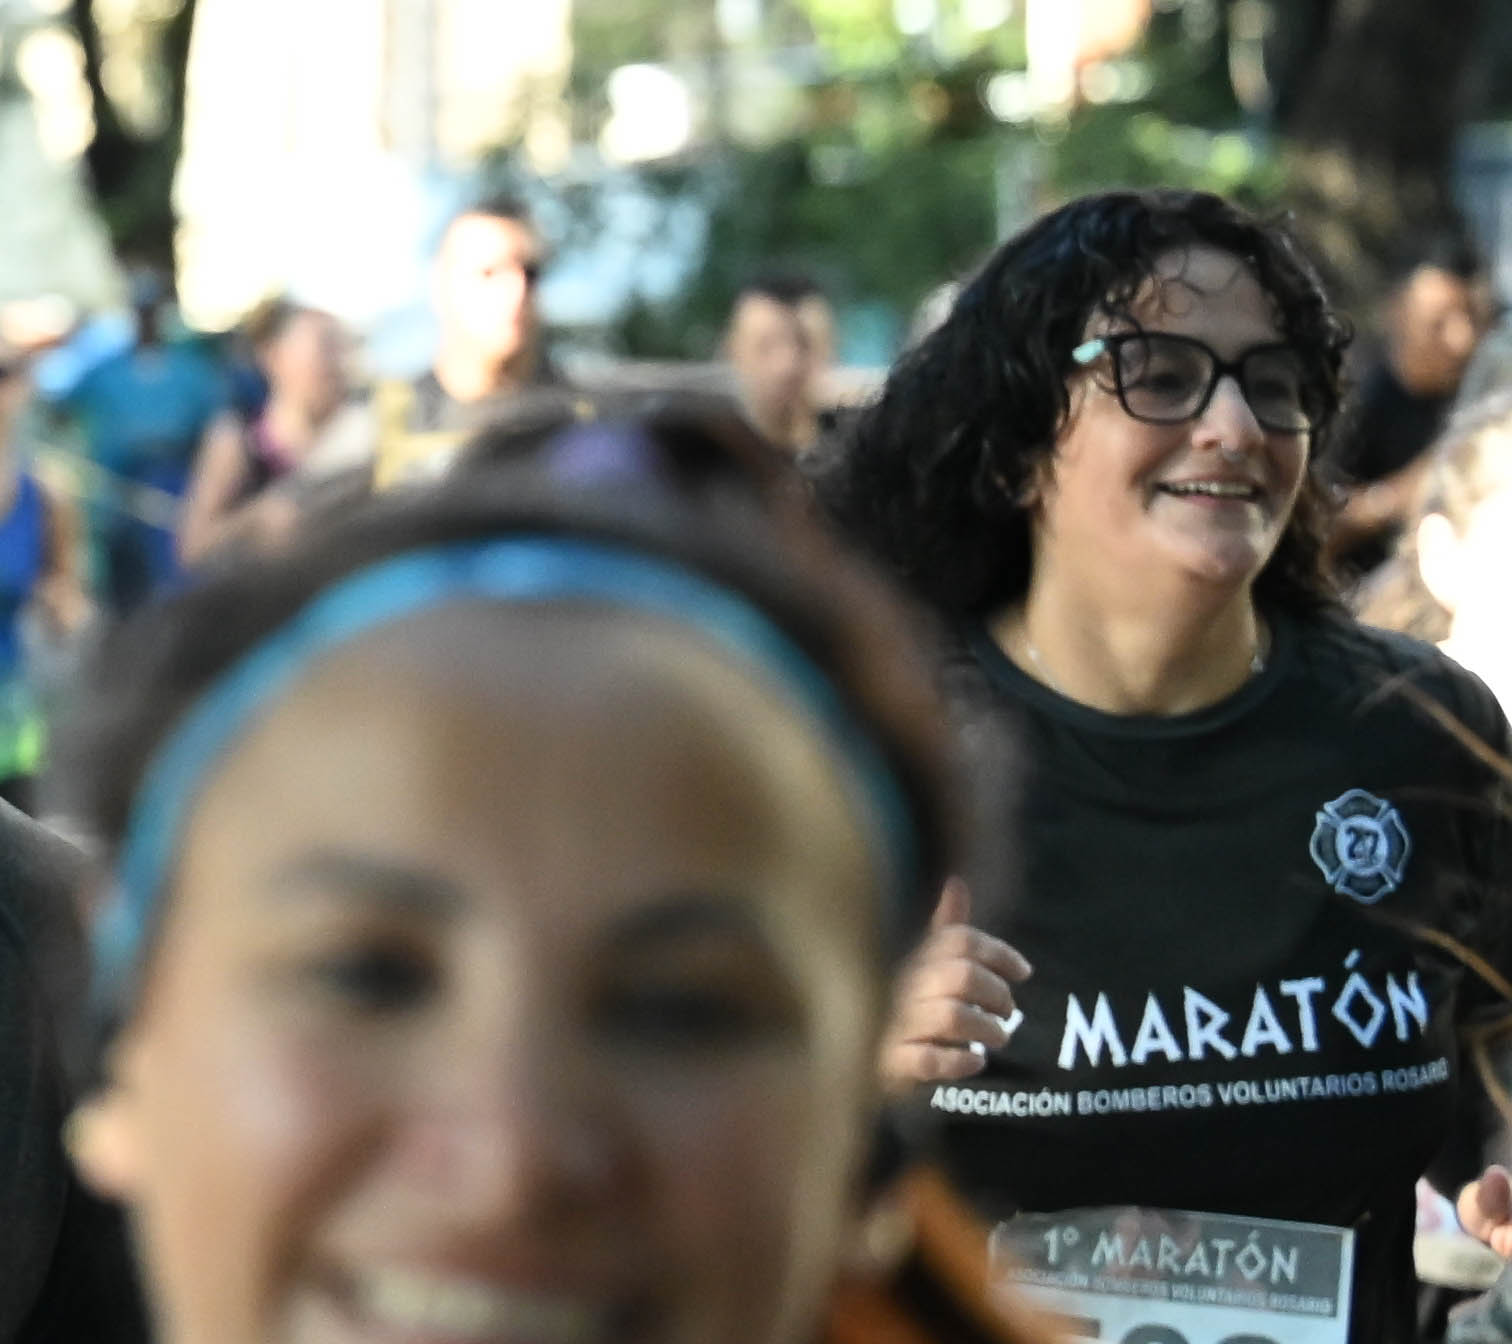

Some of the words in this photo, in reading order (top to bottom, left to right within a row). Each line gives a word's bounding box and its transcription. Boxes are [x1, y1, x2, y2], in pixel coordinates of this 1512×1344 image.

[1057, 949, 1429, 1070] MARATÓN
[930, 1085, 1072, 1117] ASOCIACIÓN
[1077, 1082, 1213, 1116] BOMBEROS
[1217, 1071, 1378, 1106] VOLUNTARIOS
[1091, 1229, 1299, 1285] MARATÓN
